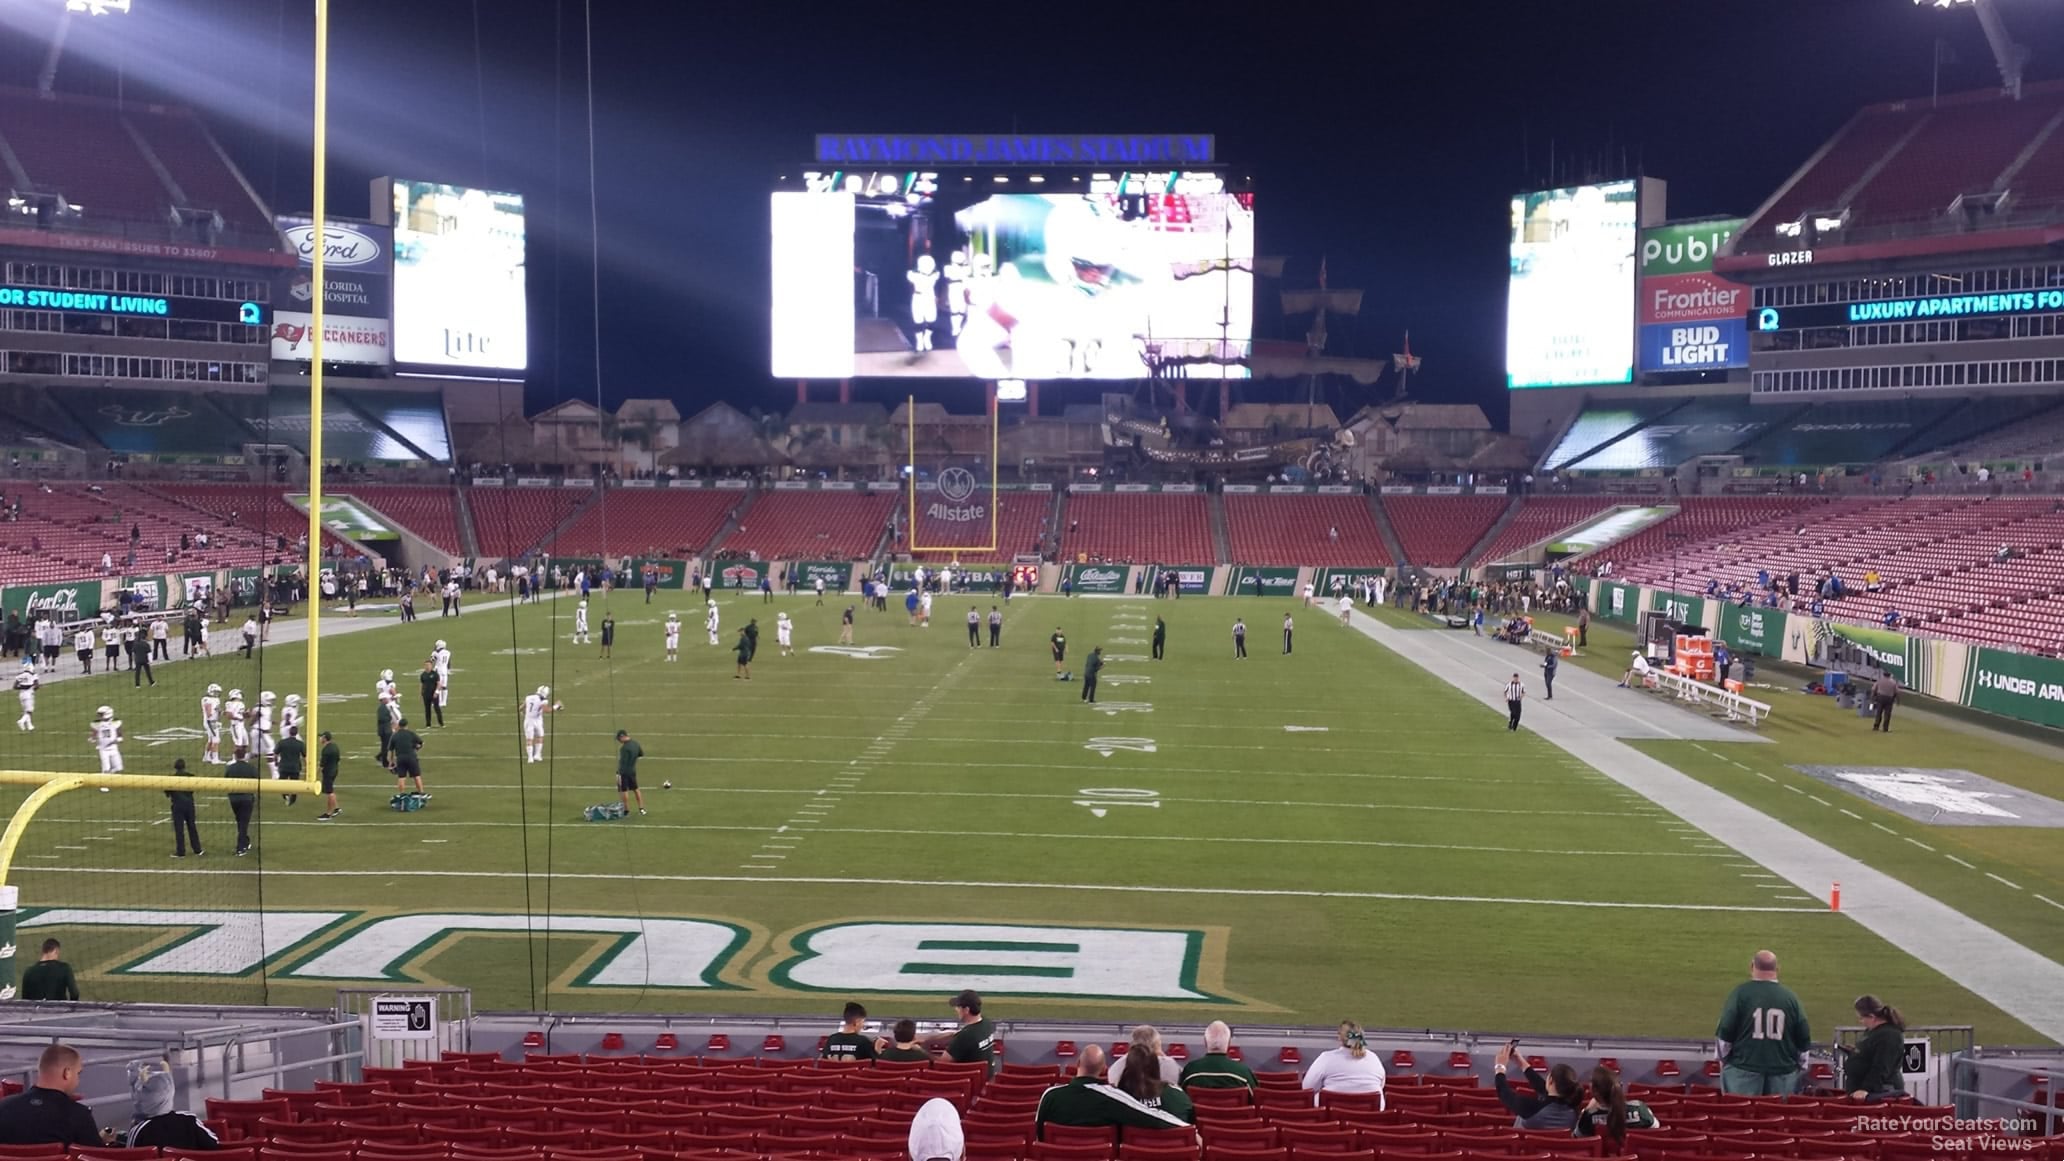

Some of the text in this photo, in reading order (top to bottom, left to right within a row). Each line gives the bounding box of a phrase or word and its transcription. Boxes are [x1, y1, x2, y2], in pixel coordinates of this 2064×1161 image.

[819, 136, 1211, 161] RAYMOND JAMES STADIUM
[164, 246, 180, 256] TO
[299, 232, 360, 259] Frd
[1642, 231, 1731, 267] Publi
[1768, 250, 1813, 266] GLAZER
[322, 280, 364, 293] LORIDA
[27, 290, 109, 311] STUDENT
[111, 296, 168, 315] LIVING
[1654, 287, 1741, 311] Frontier
[1851, 291, 2064, 321] LUXURY APARTMENTS FO
[1654, 306, 1735, 319] COMMUNICATIONS
[307, 327, 387, 347] BCCANEERS
[1672, 326, 1720, 347] BUD
[1662, 344, 1729, 365] LIGHT
[927, 503, 985, 522] Allstate
[1993, 673, 2036, 697] UNDER
[378, 1004, 411, 1012] WARNING
[1752, 1007, 1786, 1041] 10
